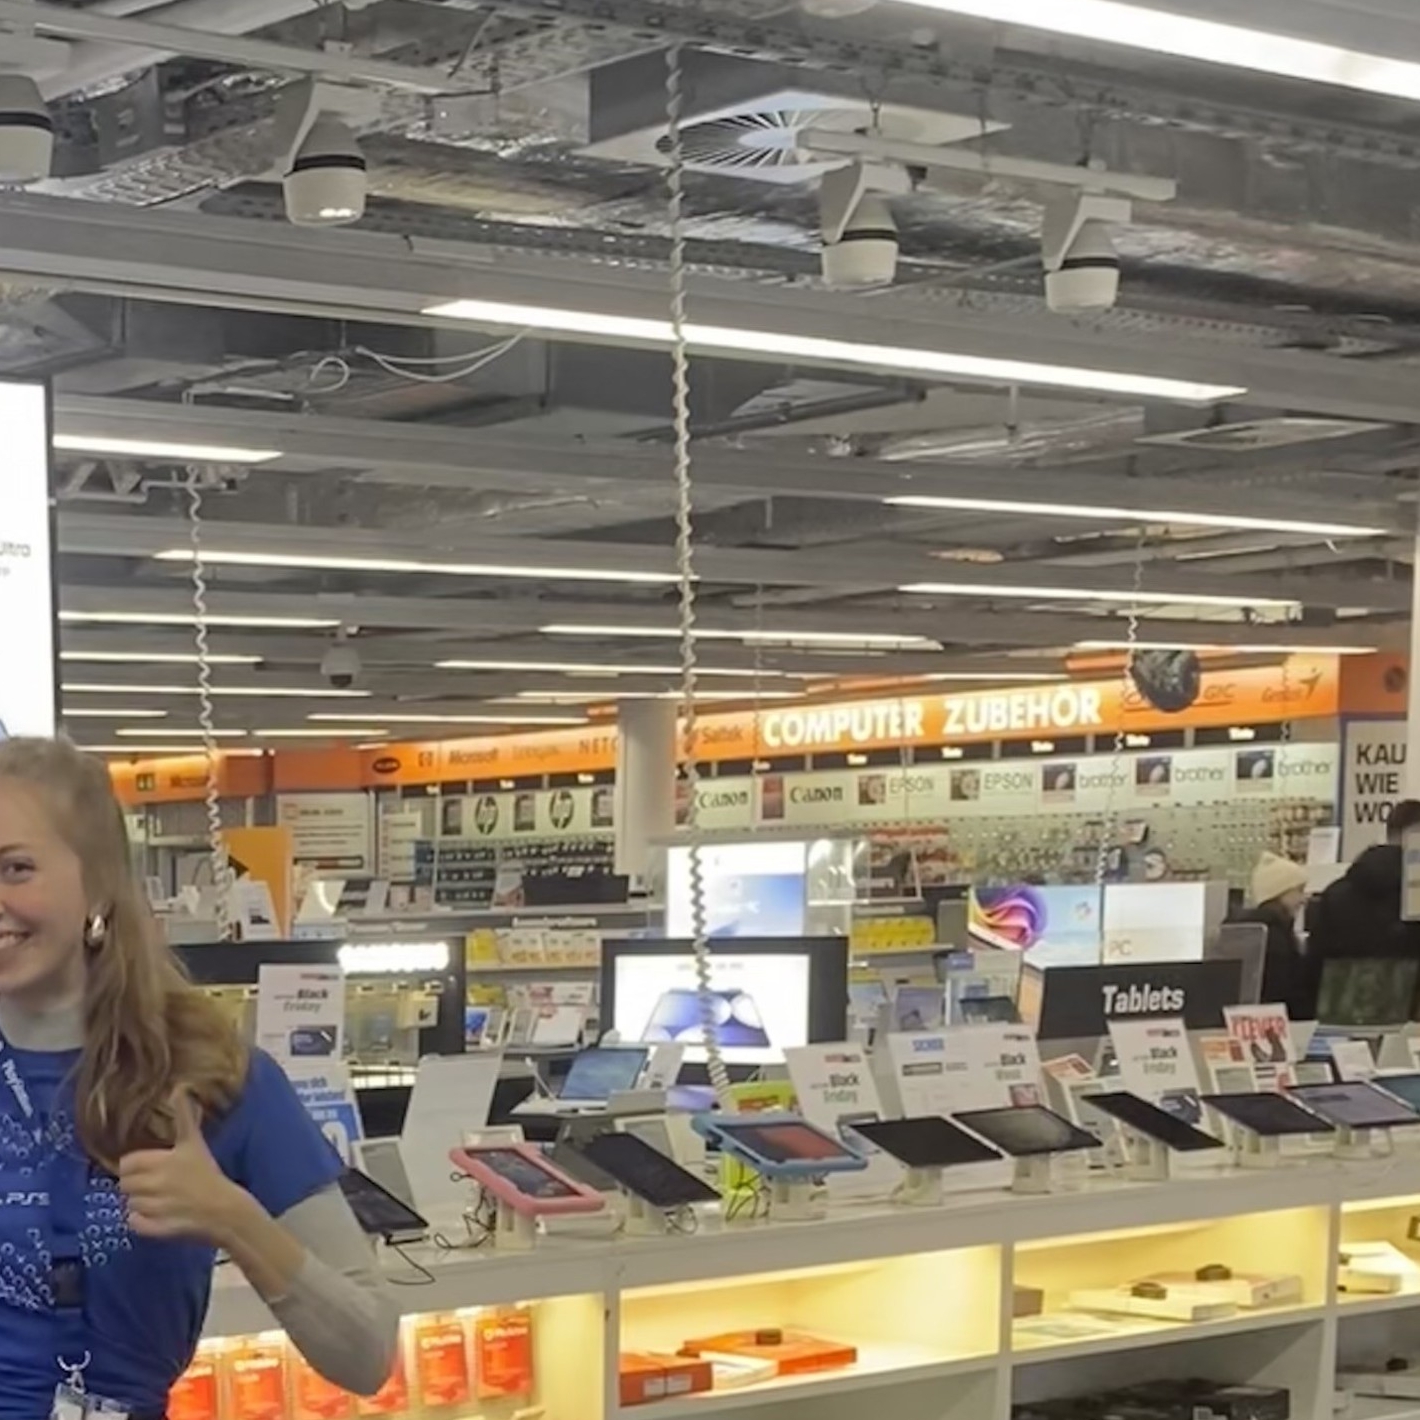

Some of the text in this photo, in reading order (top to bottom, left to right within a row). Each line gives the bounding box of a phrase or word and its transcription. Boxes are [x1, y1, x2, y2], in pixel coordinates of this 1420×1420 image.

[761, 685, 1103, 747] COMPUTER ZUBEHÖR
[1356, 743, 1407, 765] KAU
[1175, 765, 1227, 782] brother
[1278, 758, 1334, 777] brother
[889, 776, 935, 795] EPSON
[984, 771, 1033, 791] EPSON
[1080, 771, 1129, 789] brother
[1355, 773, 1398, 794] WIE
[699, 790, 749, 809] Canon
[790, 785, 843, 805] Canon
[297, 988, 329, 1000] Black
[1101, 982, 1184, 1014] Tablets
